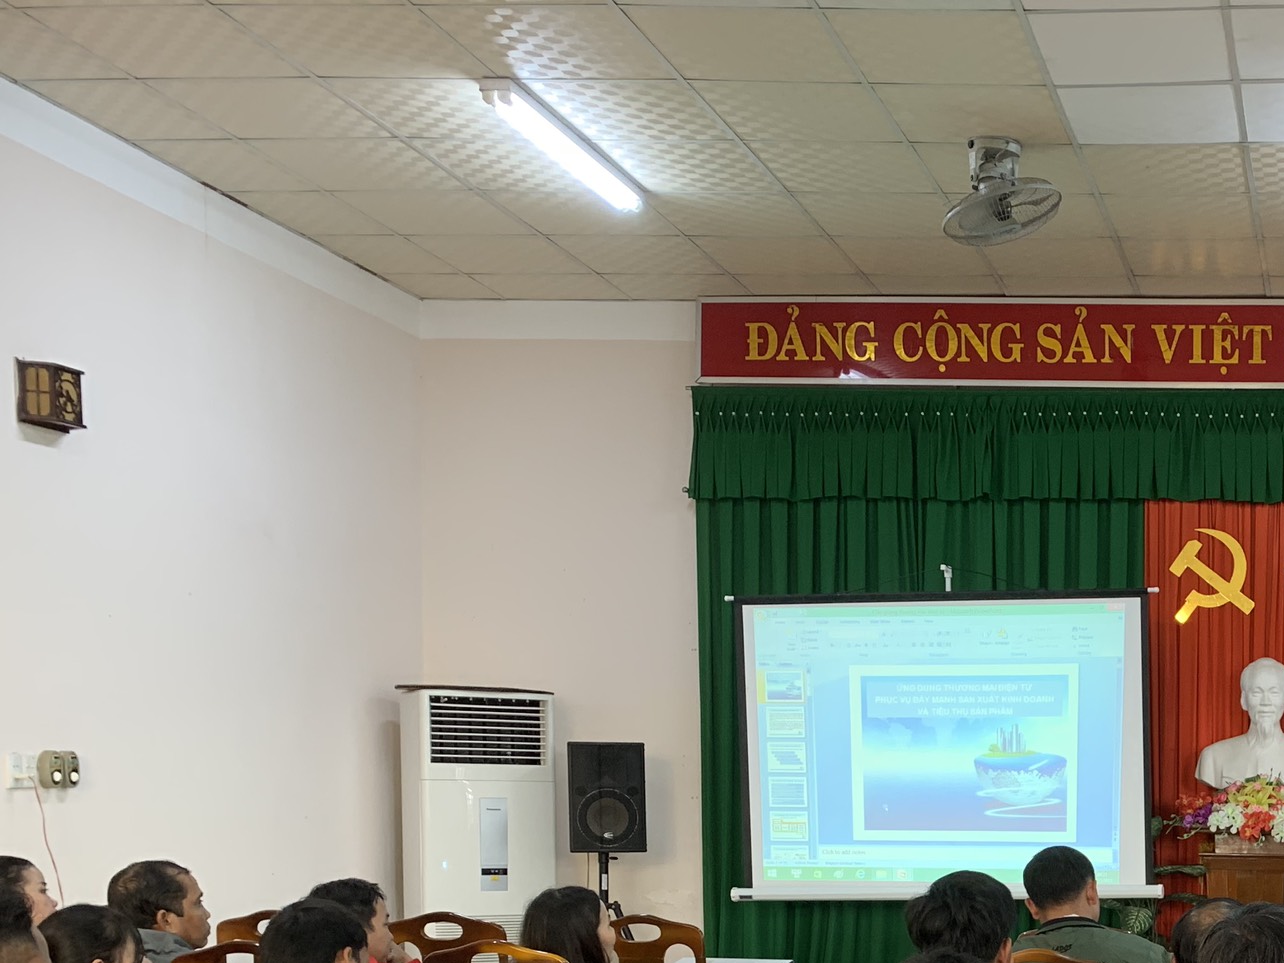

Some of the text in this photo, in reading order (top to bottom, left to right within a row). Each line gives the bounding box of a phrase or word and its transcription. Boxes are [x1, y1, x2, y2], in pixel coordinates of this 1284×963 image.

[744, 305, 879, 362] ĐẢNG
[894, 310, 1025, 373] CỘNG
[1037, 306, 1134, 364] SẢN
[1151, 313, 1272, 375] VIỆT
